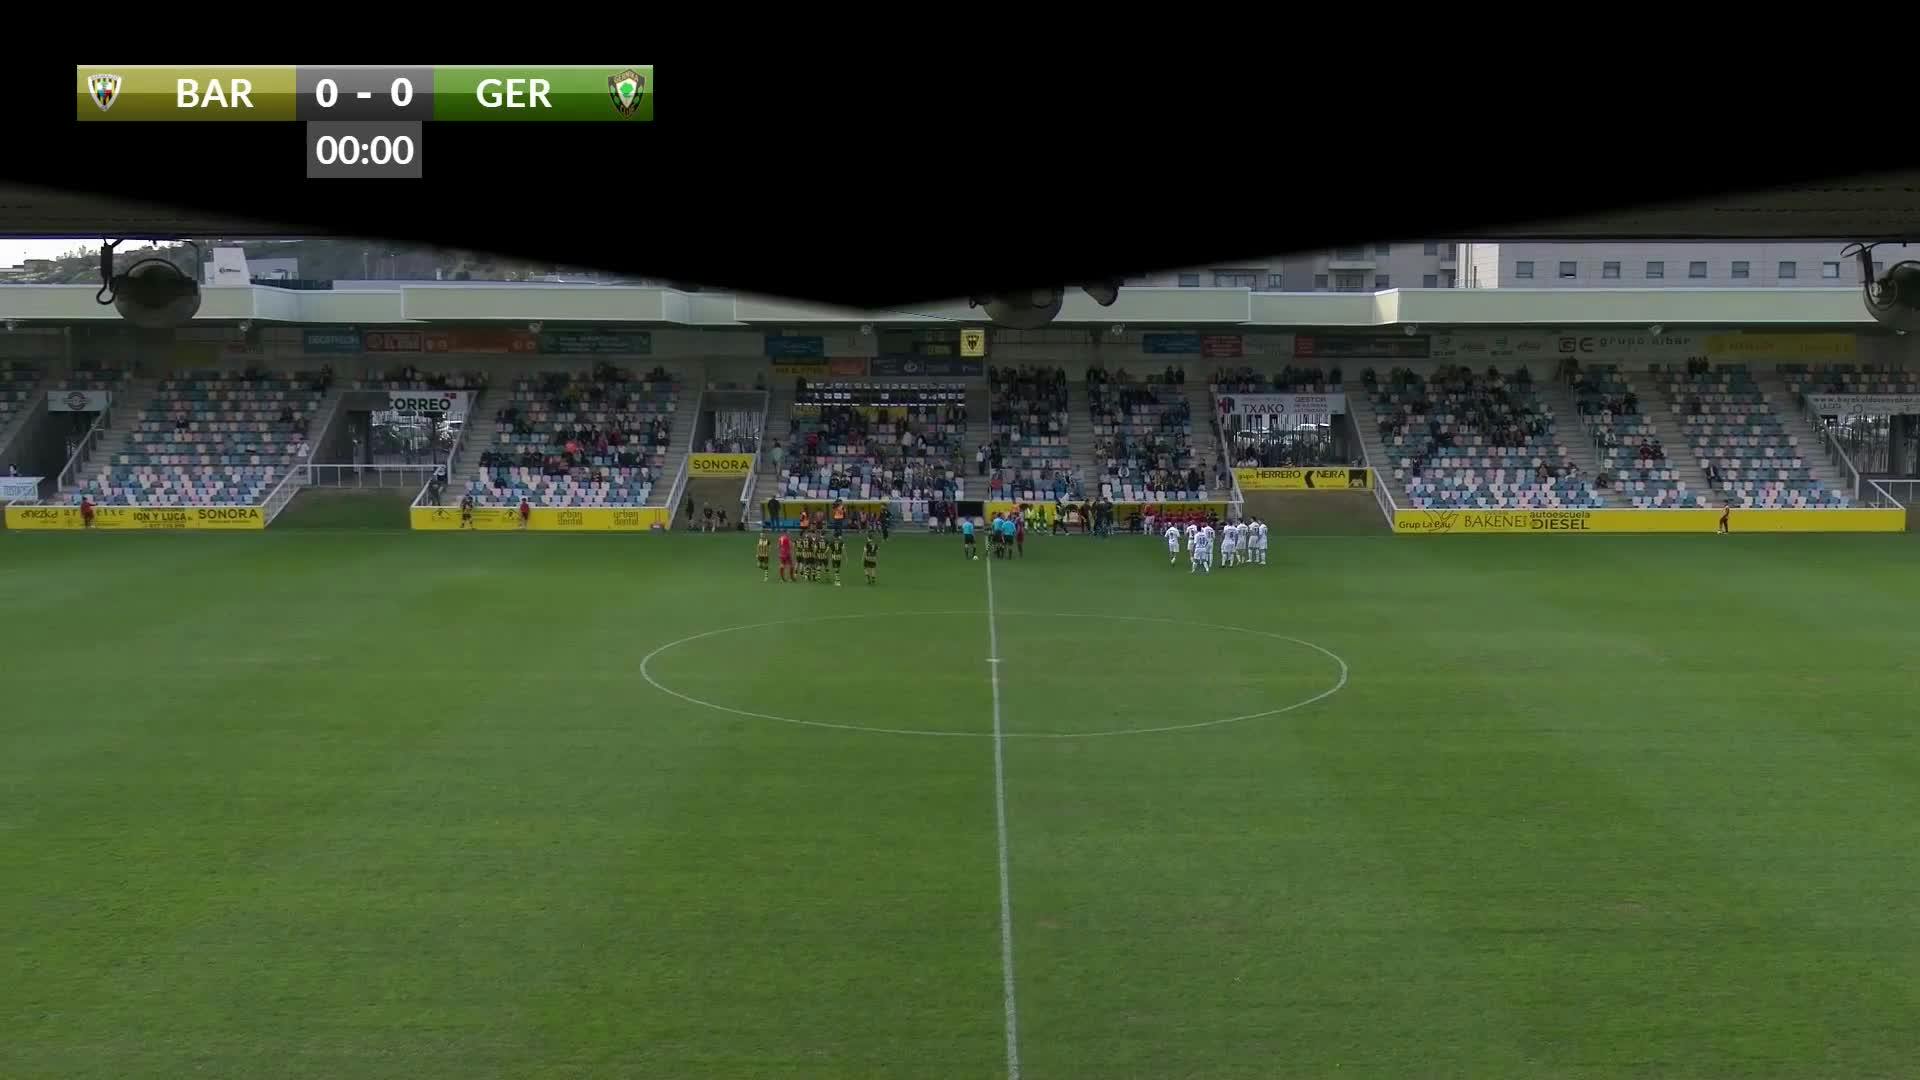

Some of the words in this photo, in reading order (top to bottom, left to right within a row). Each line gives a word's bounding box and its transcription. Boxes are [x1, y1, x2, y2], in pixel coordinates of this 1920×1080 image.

[1241, 403, 1285, 414] TXAKO
[693, 459, 750, 470] SONORA
[1256, 470, 1301, 479] HERRERO
[1316, 470, 1346, 479] NEIRA
[133, 512, 151, 521] ION
[152, 512, 159, 521] Y
[161, 512, 187, 521] LUCA
[198, 508, 260, 519] SONORA
[1529, 511, 1591, 519] autoescuela
[1399, 521, 1420, 531] Grup
[1531, 518, 1591, 530] DIESEL
